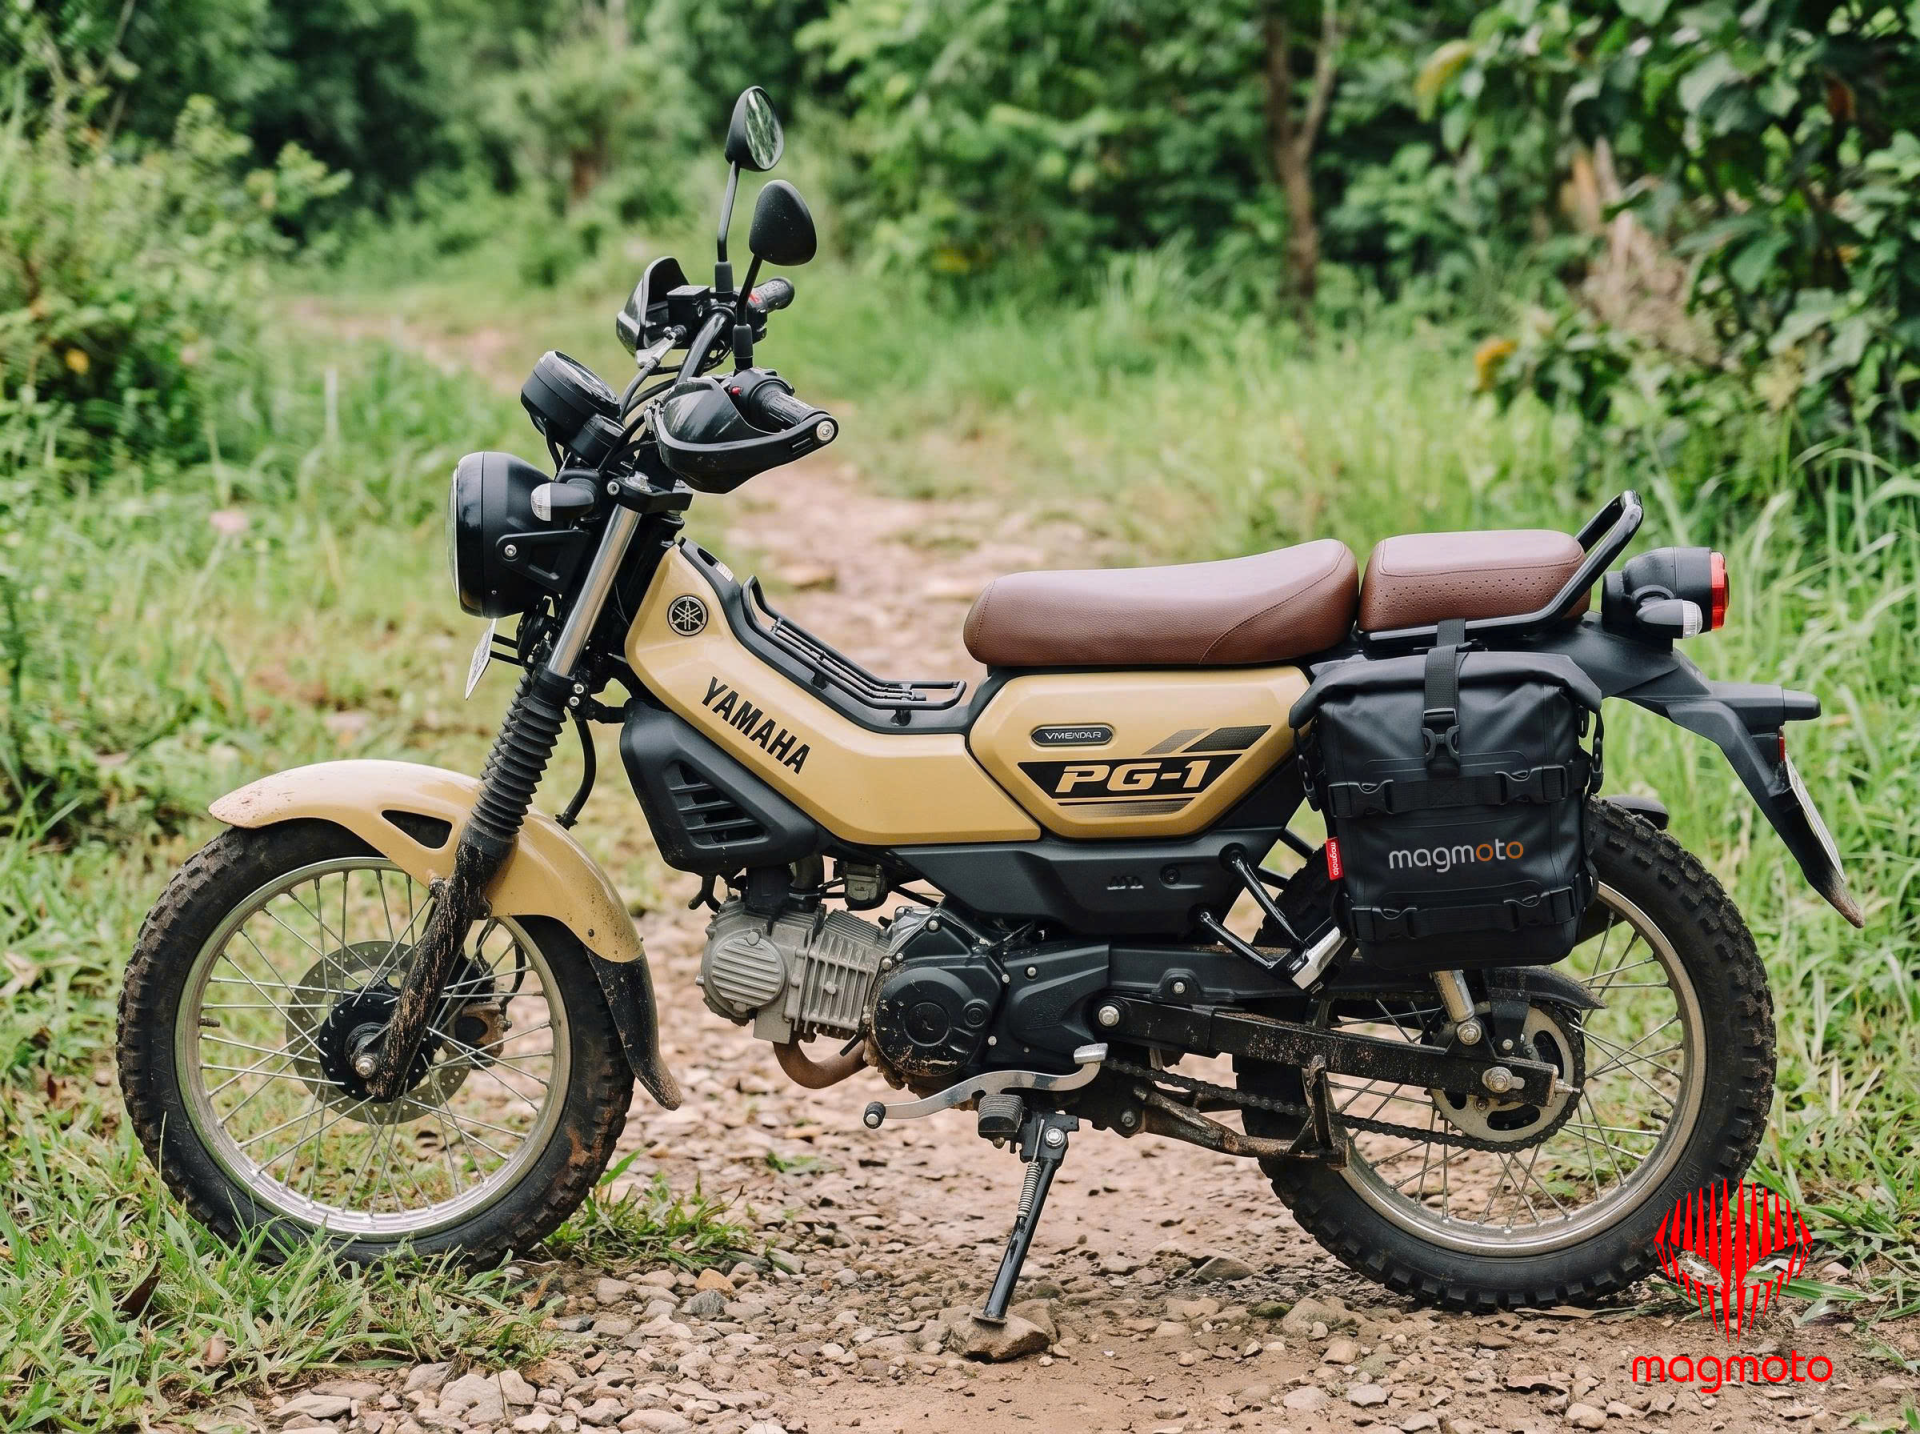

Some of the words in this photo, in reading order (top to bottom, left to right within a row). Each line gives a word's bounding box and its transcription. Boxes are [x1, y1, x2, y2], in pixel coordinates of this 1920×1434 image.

[702, 676, 811, 774] YAMAHA
[1054, 759, 1211, 793] PG-1
[1330, 842, 1339, 876] magmoto
[1388, 838, 1524, 873] magmoto
